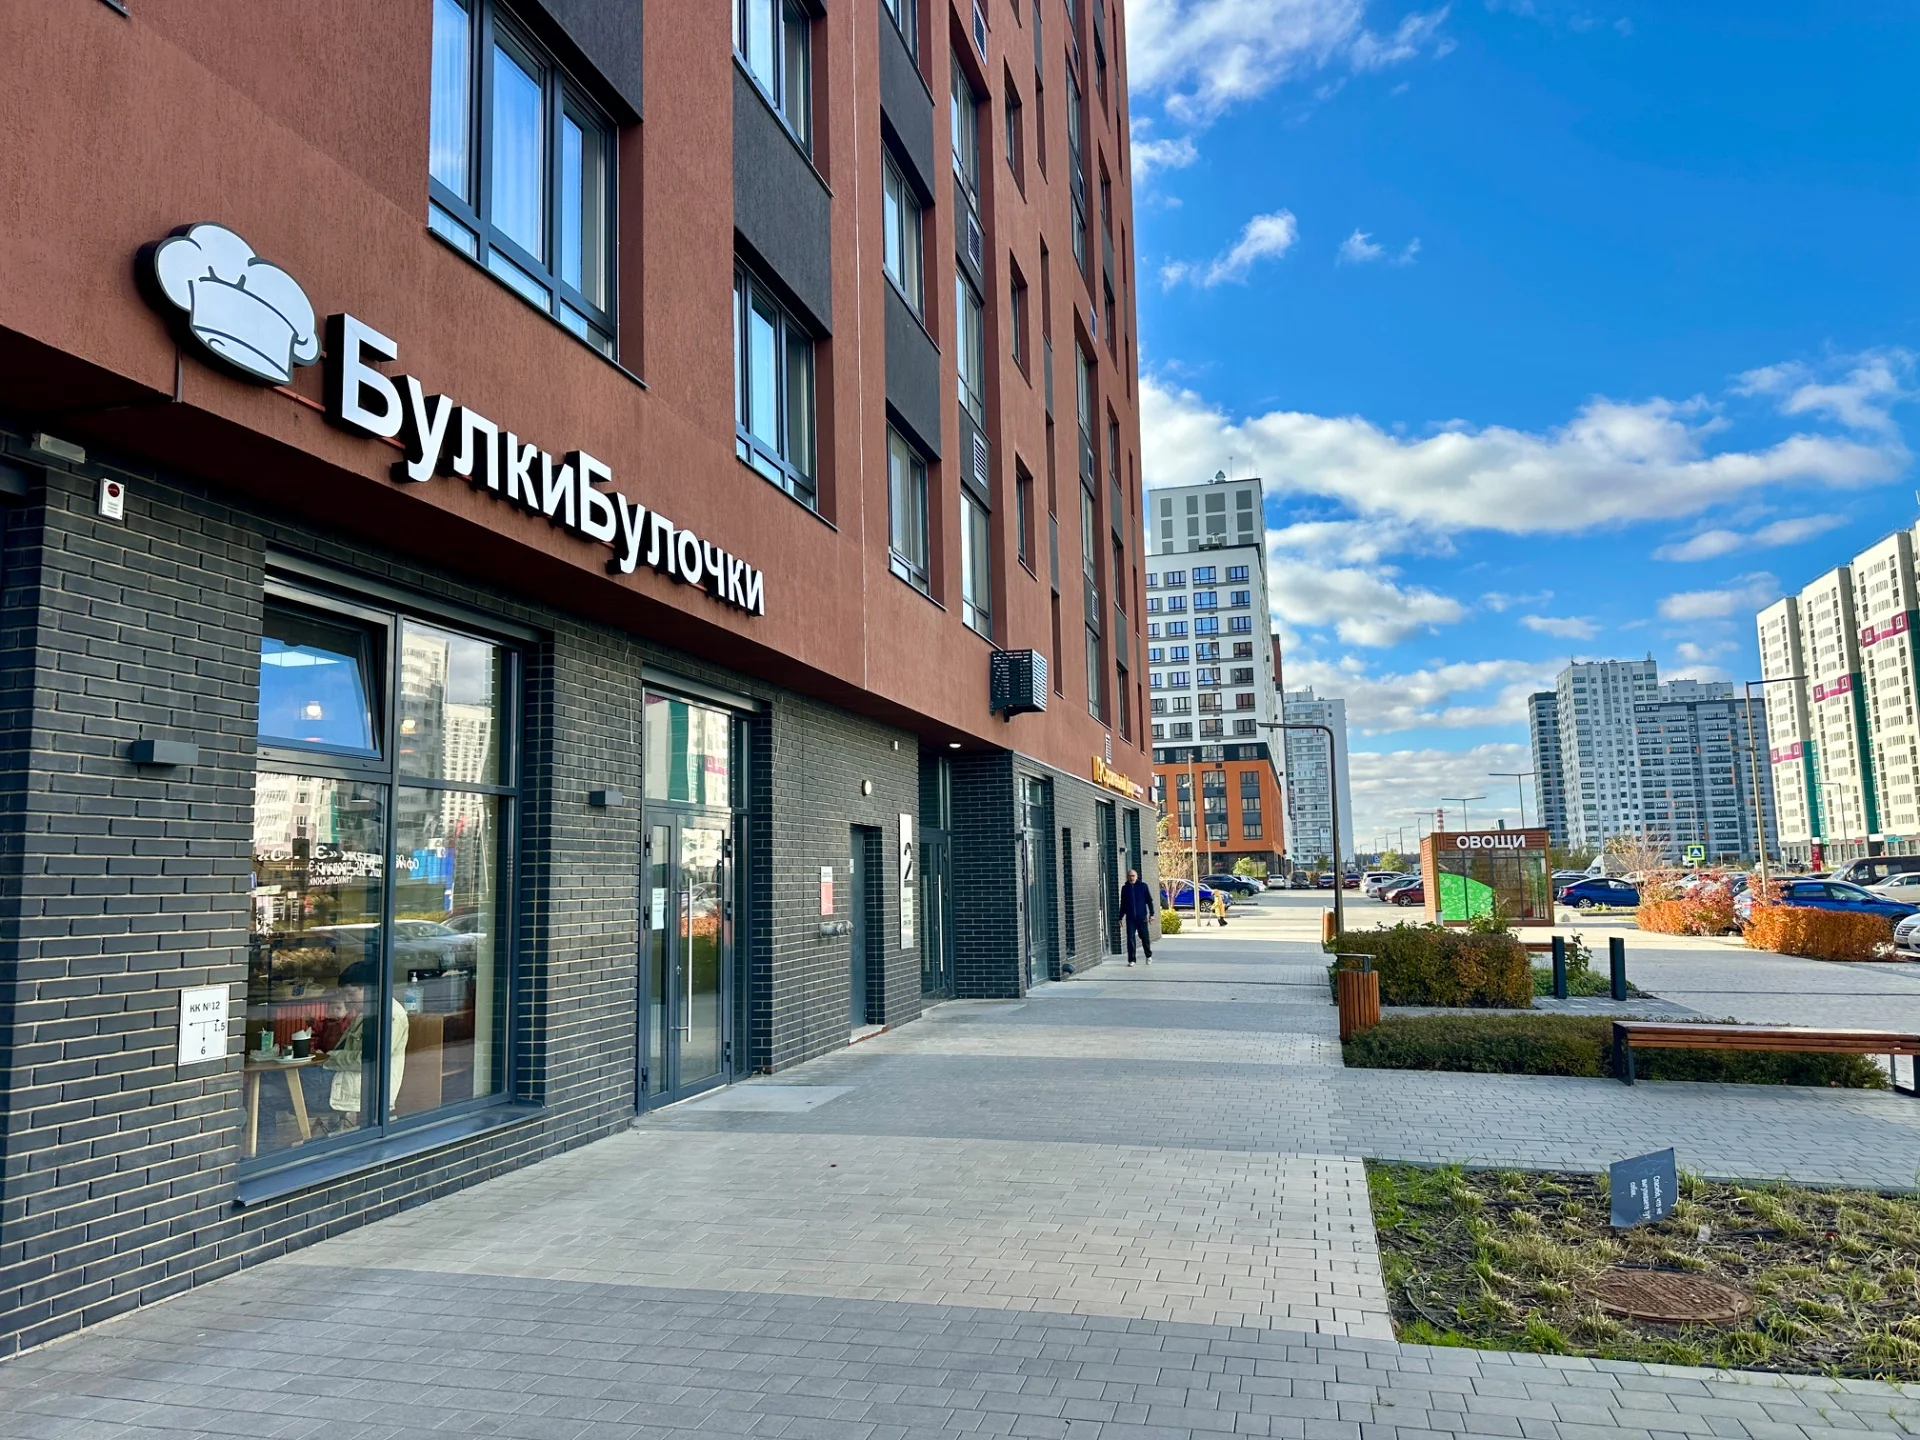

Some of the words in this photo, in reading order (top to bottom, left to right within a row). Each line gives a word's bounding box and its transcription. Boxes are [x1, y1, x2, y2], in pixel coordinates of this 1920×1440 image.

[334, 312, 765, 616] БулкиБулочки
[1456, 834, 1526, 850] ОВОЩИ
[903, 842, 914, 888] 2
[200, 1046, 206, 1055] 6
